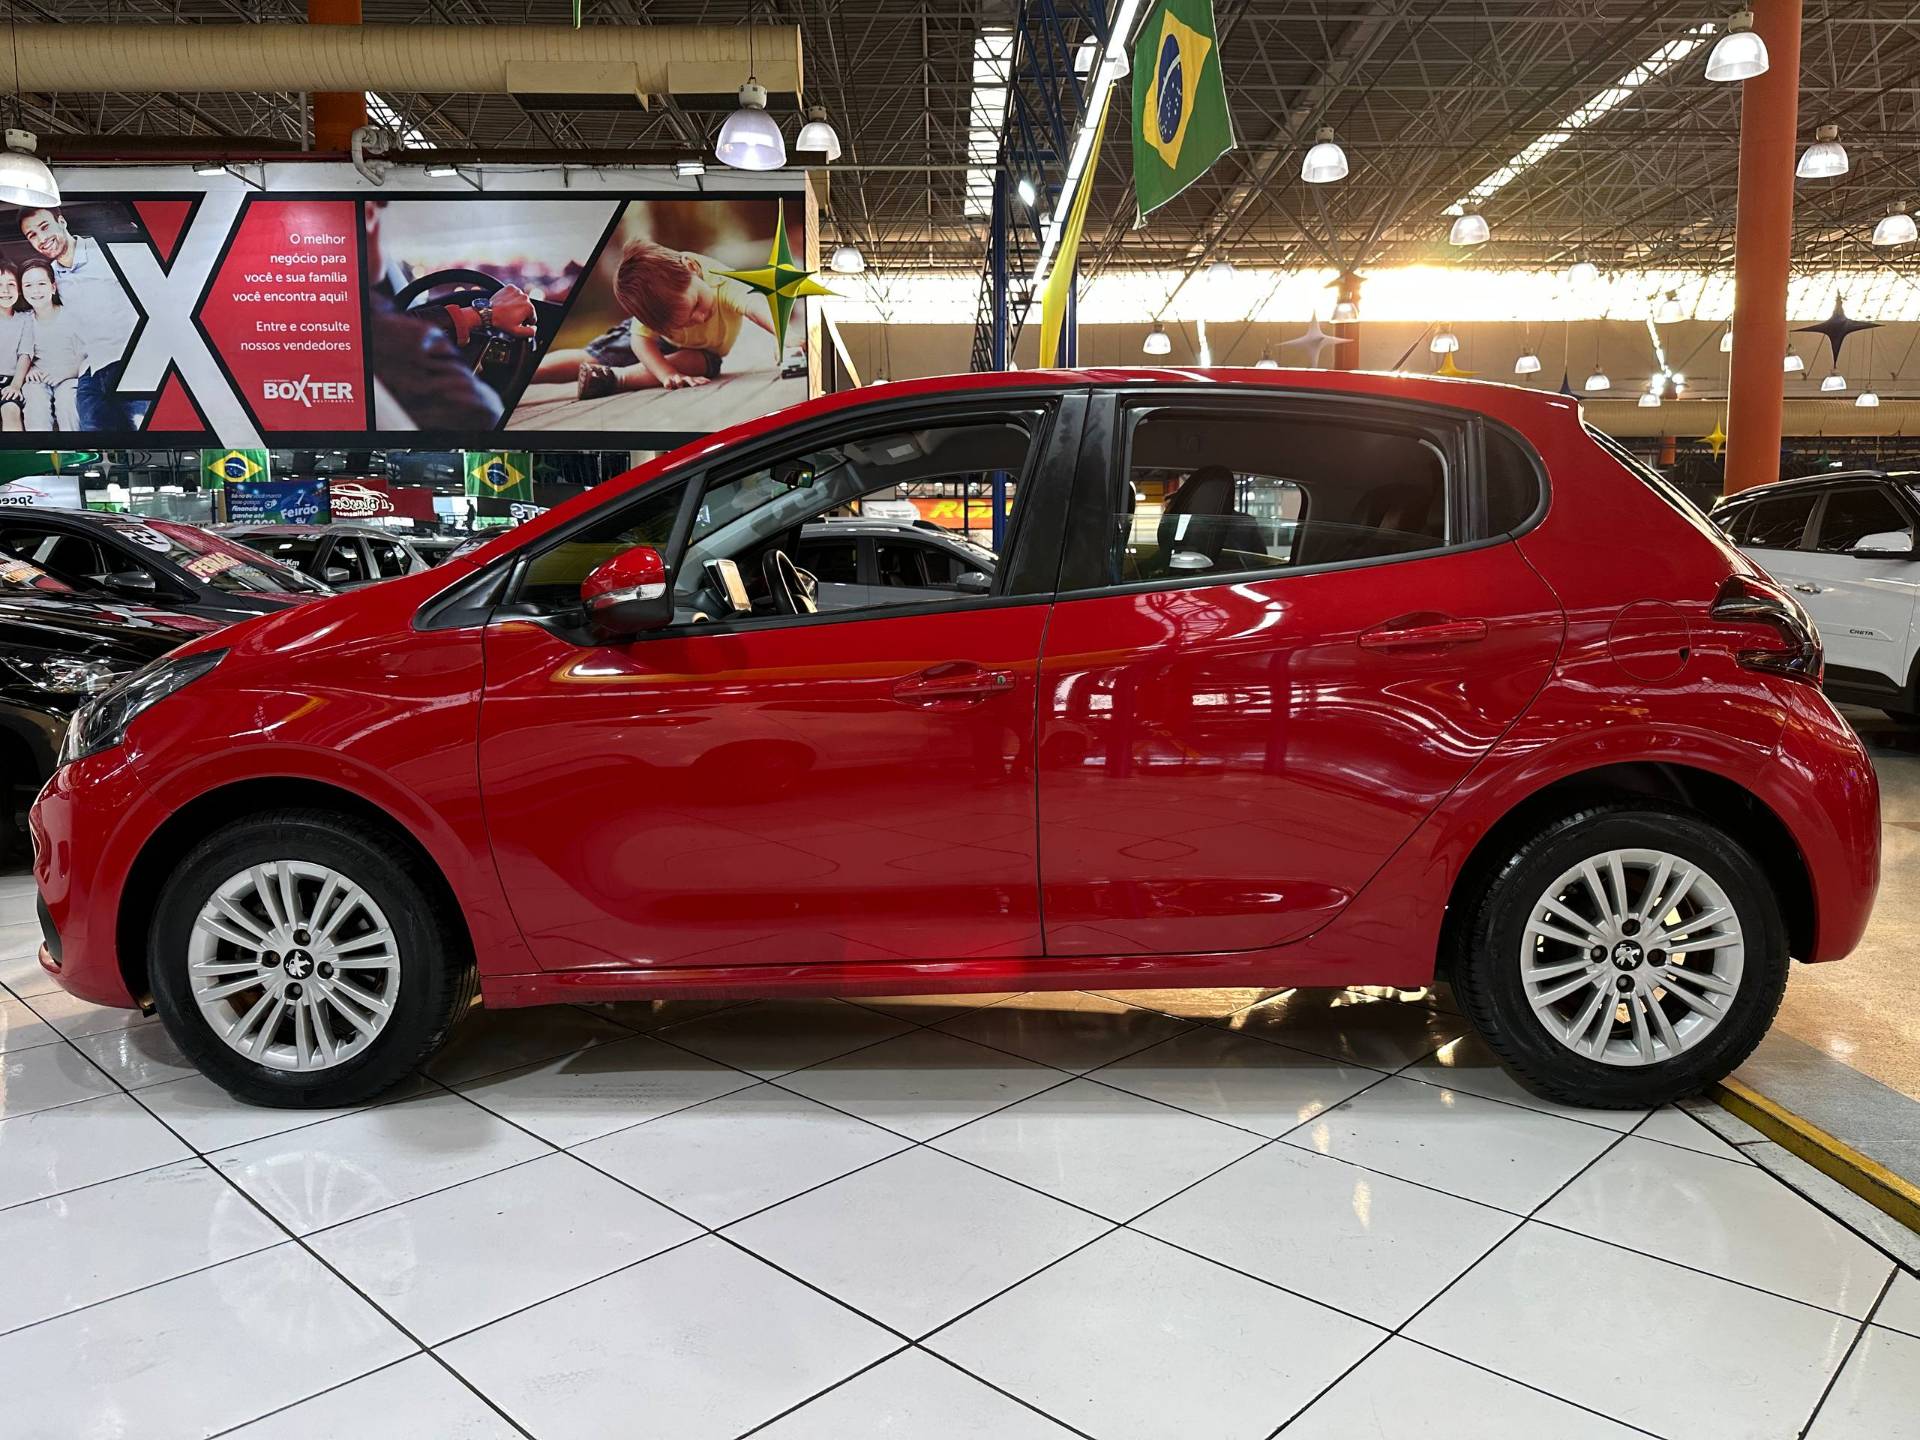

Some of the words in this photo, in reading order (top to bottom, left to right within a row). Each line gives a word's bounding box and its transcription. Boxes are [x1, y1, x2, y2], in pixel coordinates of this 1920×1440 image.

[290, 233, 301, 245] O
[303, 233, 346, 245] melhor
[270, 253, 318, 266] negócio
[321, 254, 347, 266] para
[244, 272, 273, 283] você
[275, 274, 283, 283] e
[285, 274, 306, 283] sua
[308, 272, 348, 283] família
[232, 291, 261, 302] você
[264, 292, 317, 302] encontra
[319, 291, 349, 304] aqui!
[256, 321, 287, 332] Entre
[290, 323, 297, 332] e
[300, 321, 350, 332] consulte
[240, 342, 281, 351] nossos
[283, 340, 352, 351] vendedores
[263, 374, 354, 408] BOXTER
[232, 512, 253, 520] ganhe
[280, 503, 319, 519] Feirão
[1849, 629, 1874, 637] CRETA
